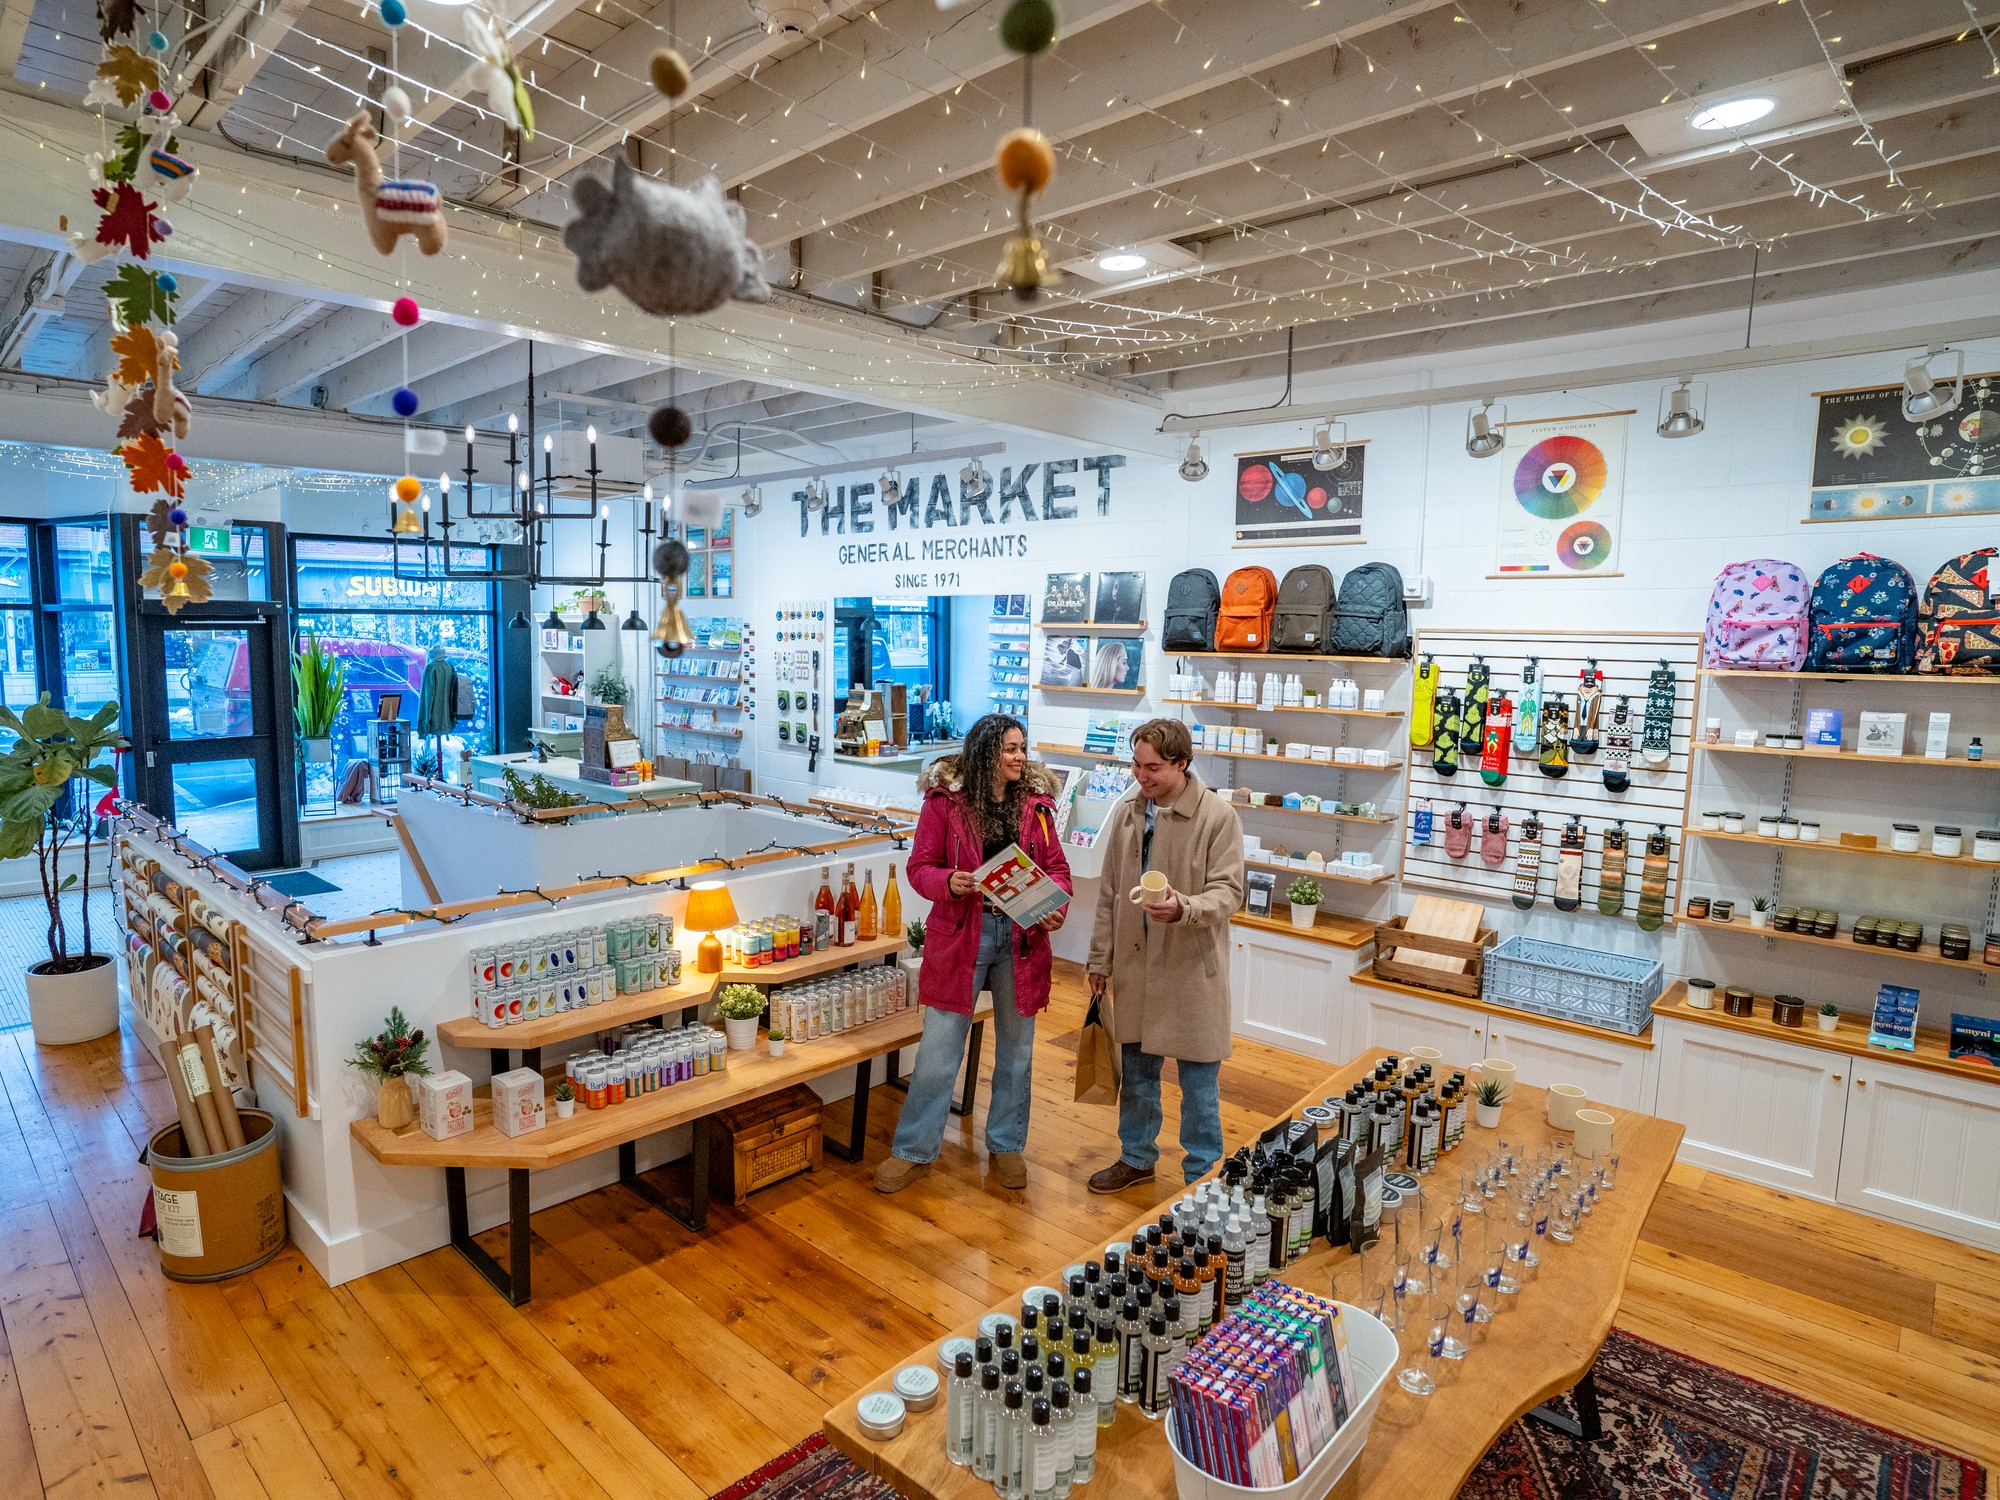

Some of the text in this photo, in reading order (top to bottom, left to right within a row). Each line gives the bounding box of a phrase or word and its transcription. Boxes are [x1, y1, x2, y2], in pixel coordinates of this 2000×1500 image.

[1844, 393, 1876, 402] PHASES
[792, 454, 1126, 538] THE MARKET
[838, 534, 1028, 565] GENERAL MERCHANTS
[895, 572, 960, 588] SINCE 1971
[1964, 1028, 1991, 1038] myni
[186, 1058, 196, 1083] VINTAGE
[156, 1190, 178, 1204] TAGE
[168, 1205, 181, 1213] KIT
